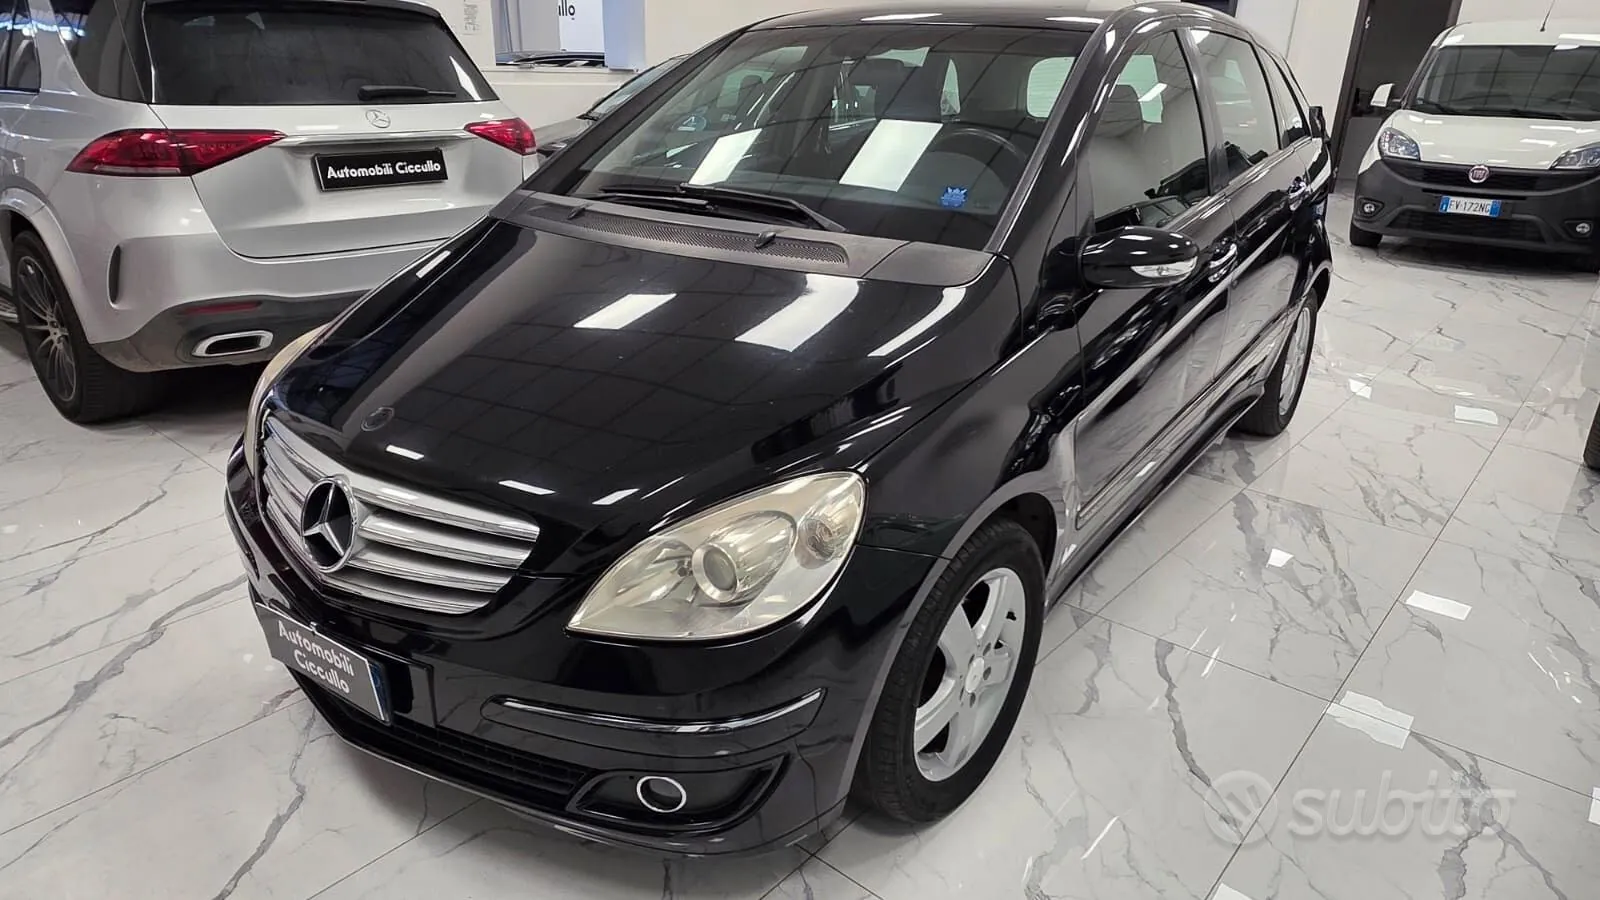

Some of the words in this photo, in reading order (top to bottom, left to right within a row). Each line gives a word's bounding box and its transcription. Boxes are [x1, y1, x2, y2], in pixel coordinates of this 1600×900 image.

[327, 163, 393, 179] Automobili
[395, 160, 441, 174] Ciccullo
[278, 619, 355, 677] Automobili
[294, 649, 351, 694] Ciccullo
